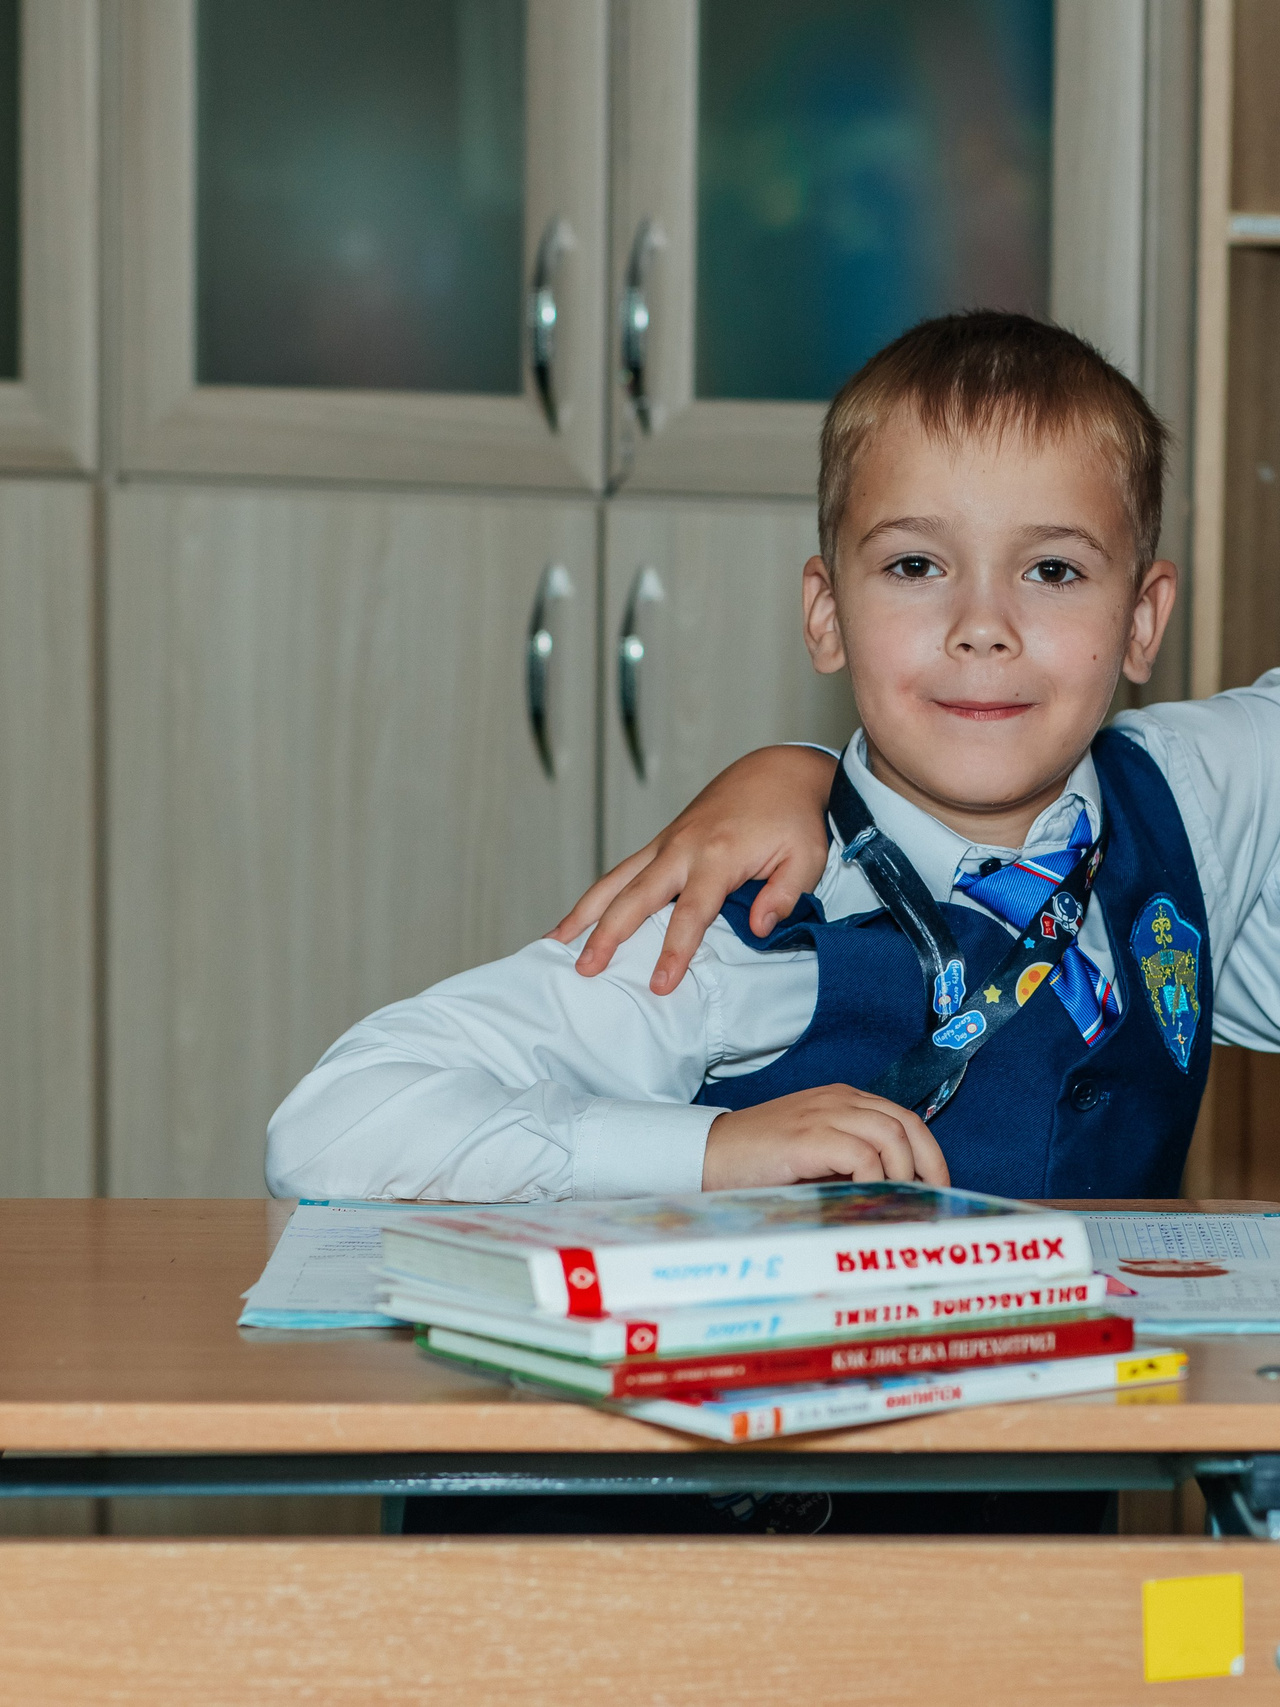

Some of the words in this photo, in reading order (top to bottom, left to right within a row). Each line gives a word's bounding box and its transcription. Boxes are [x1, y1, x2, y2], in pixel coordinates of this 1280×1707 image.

[951, 962, 960, 985] Happy
[935, 1029, 955, 1043] Happy
[954, 1015, 970, 1030] every
[954, 1032, 968, 1042] Day
[835, 1237, 1065, 1272] ХРЕСТОМАТИЯ
[933, 1286, 1089, 1317] ВНЕКЛАССНОЕ
[834, 1304, 920, 1328] ЧТЕНИЕ
